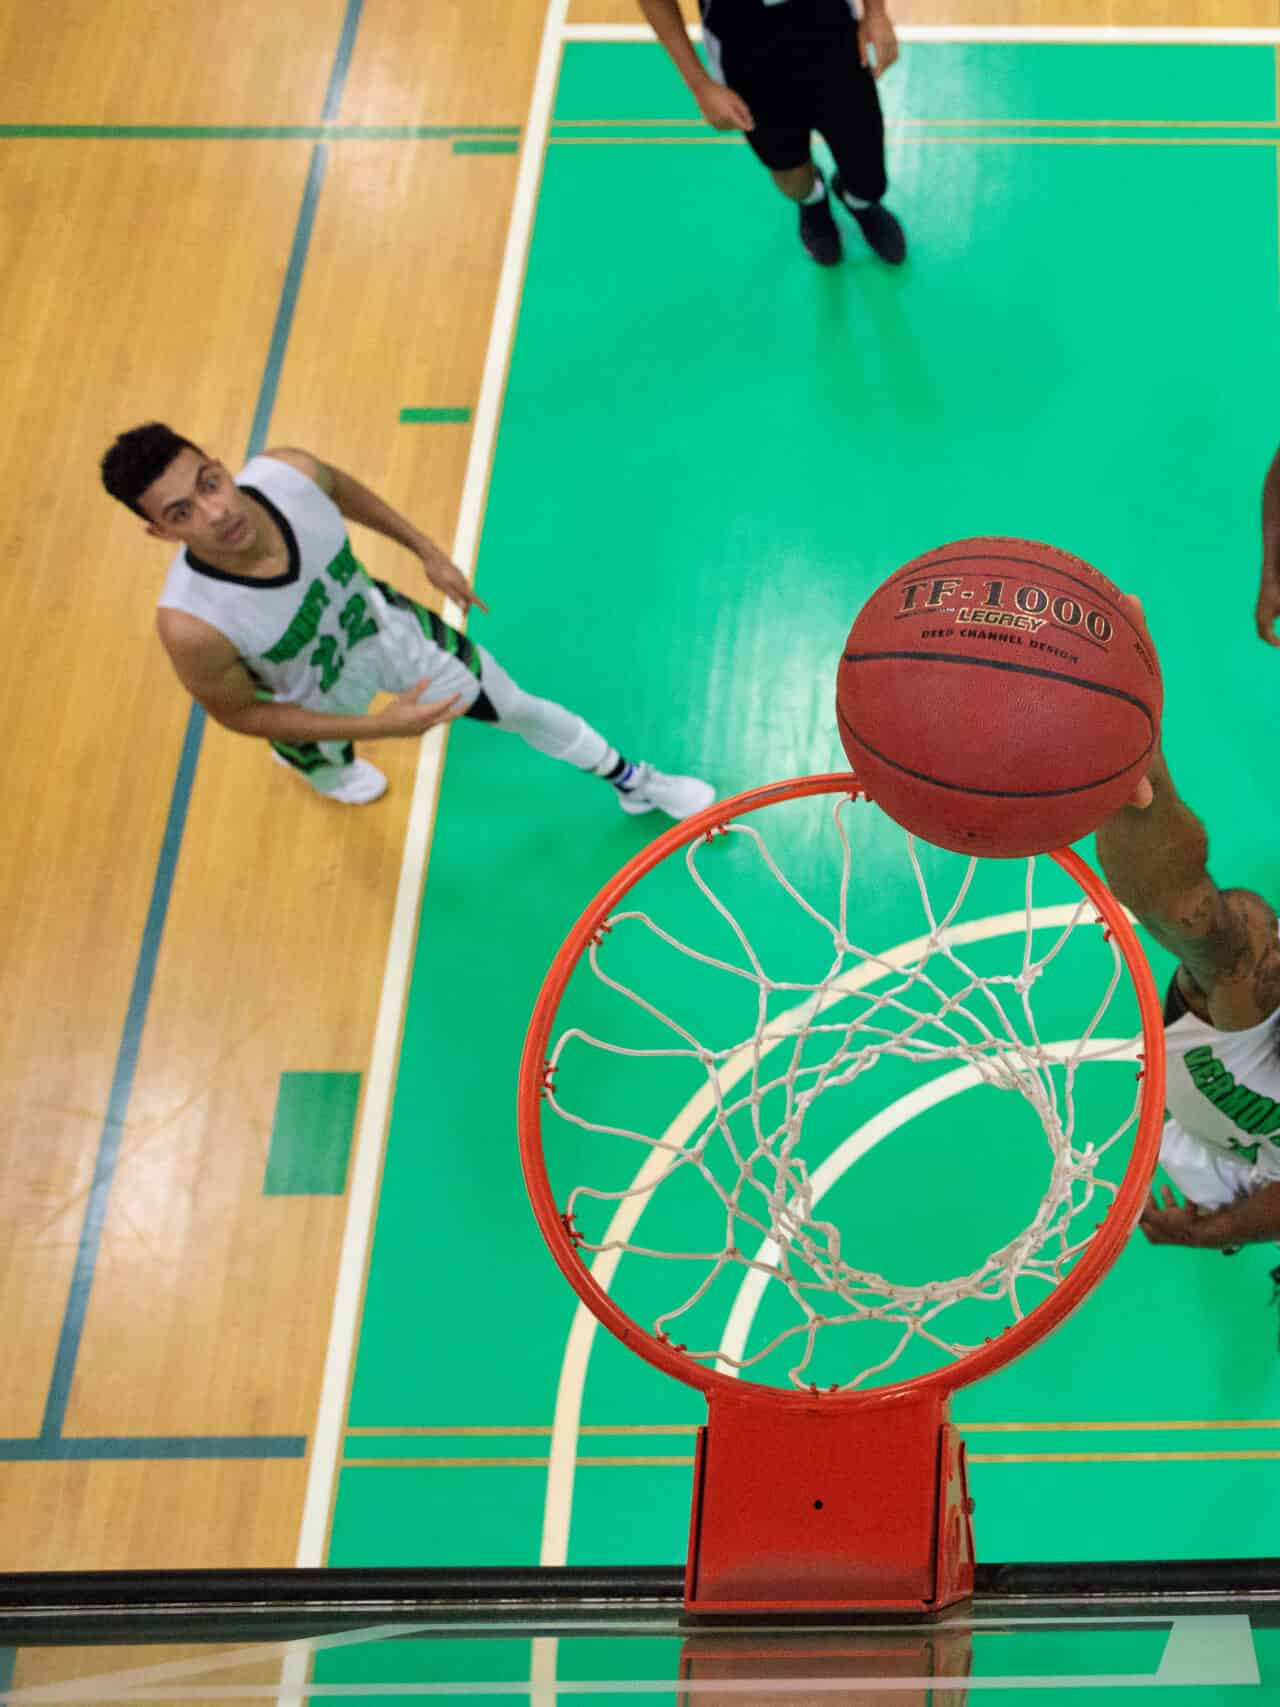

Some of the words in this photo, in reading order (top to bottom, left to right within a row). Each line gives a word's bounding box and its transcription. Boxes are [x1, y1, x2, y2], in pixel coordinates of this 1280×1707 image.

[899, 576, 1113, 644] TF-1000
[955, 607, 1048, 632] LEGACY
[311, 592, 379, 694] 22
[920, 628, 954, 639] DEEP
[960, 628, 1025, 646] CHANNEL
[1029, 638, 1081, 665] DESIGN
